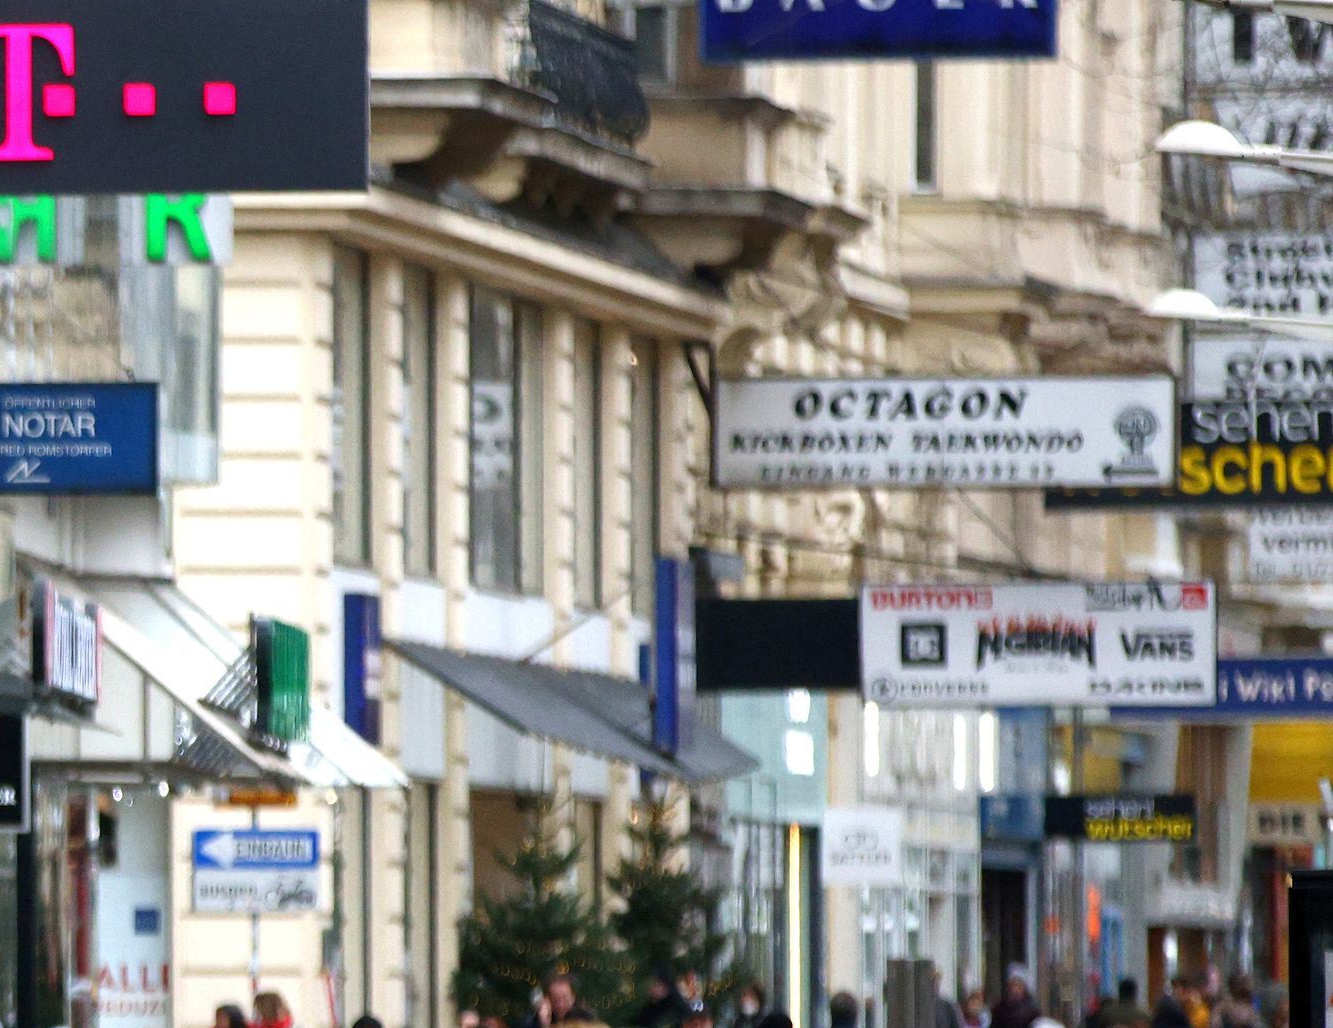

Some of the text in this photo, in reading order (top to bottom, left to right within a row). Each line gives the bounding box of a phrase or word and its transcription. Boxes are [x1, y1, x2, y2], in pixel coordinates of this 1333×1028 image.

[794, 386, 1029, 421] OCTAGON
[2, 412, 96, 438] NOTAR
[731, 431, 1084, 455] KICKBOXEN TAEKWONDO
[1180, 443, 1333, 496] sche
[871, 587, 975, 610] BURTON
[1120, 627, 1195, 661] VANS
[236, 838, 311, 859] EINBAHN
